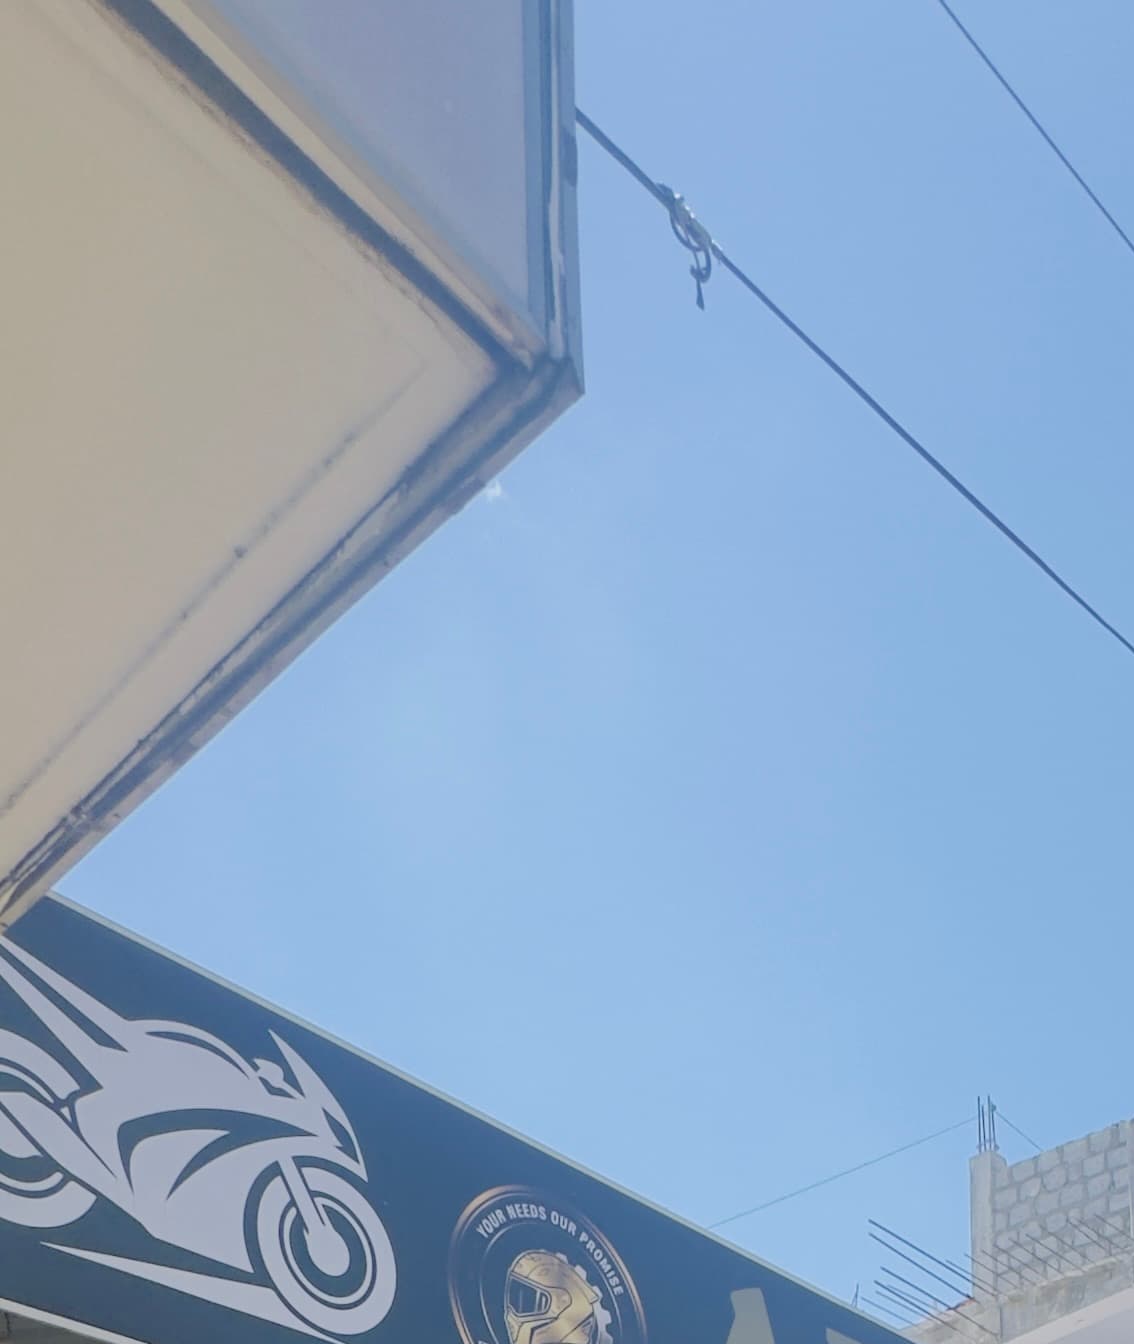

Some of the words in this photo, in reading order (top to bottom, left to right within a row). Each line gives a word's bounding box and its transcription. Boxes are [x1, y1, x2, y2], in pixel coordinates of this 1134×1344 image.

[476, 1209, 507, 1238] YOUR
[506, 1203, 547, 1220] NEEDS
[551, 1210, 577, 1236] OUR
[579, 1231, 624, 1296] PROMISE
